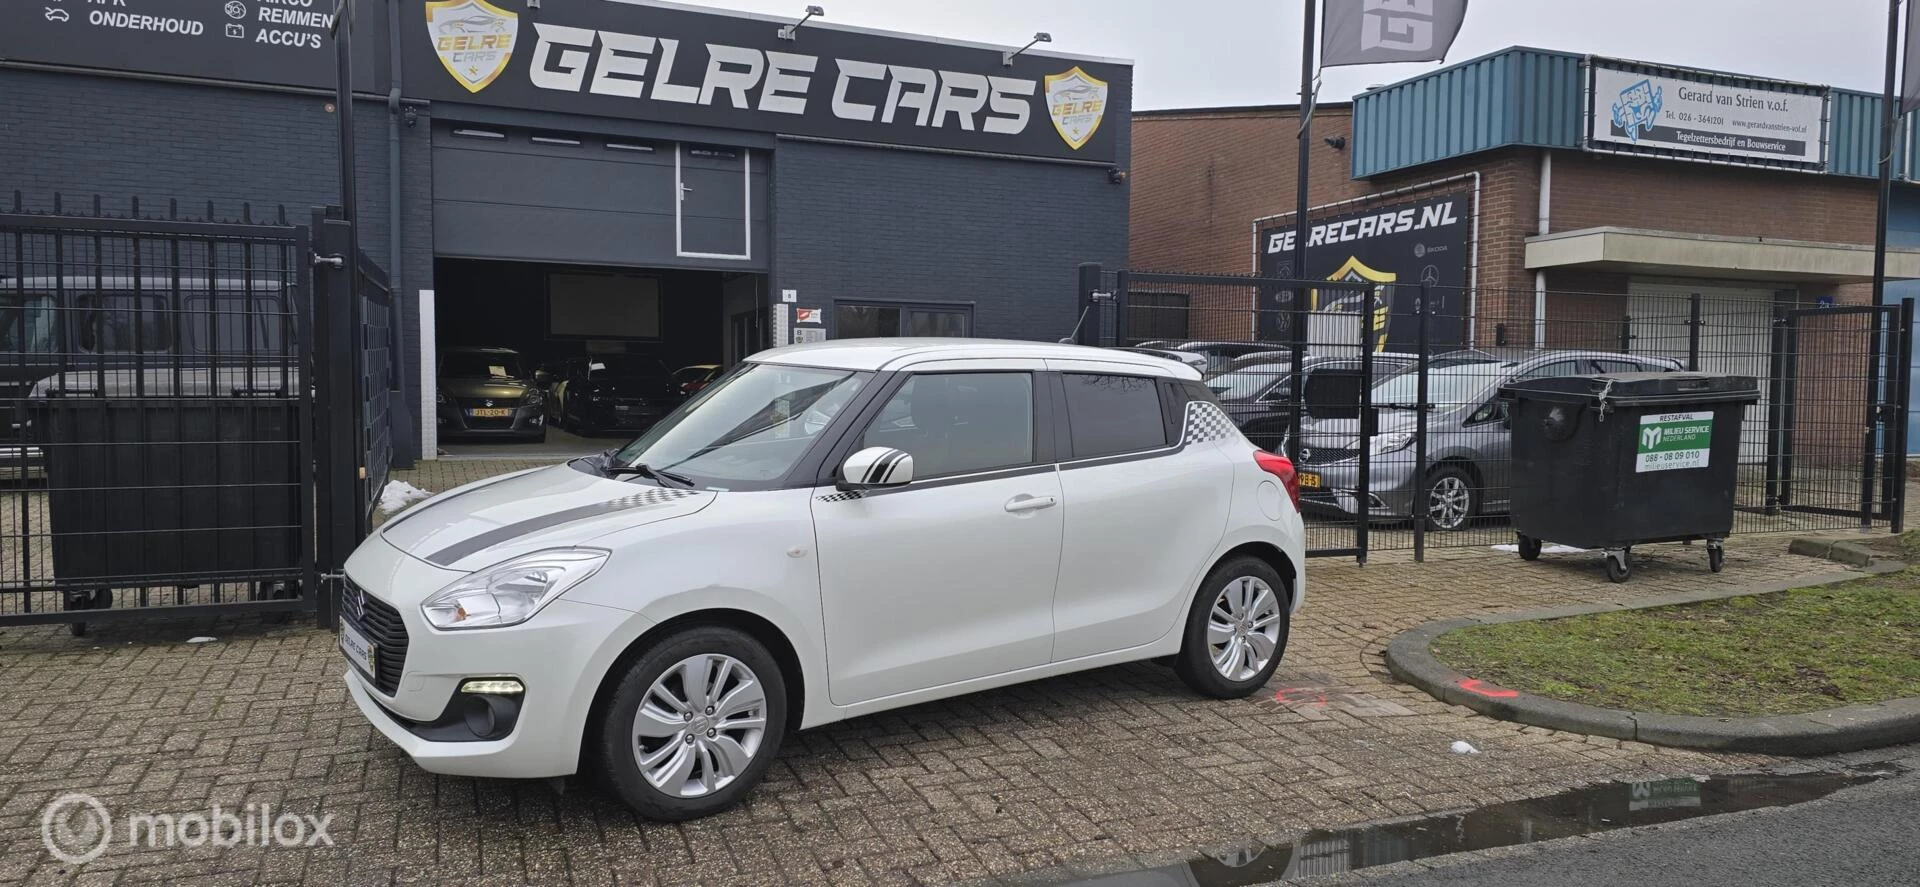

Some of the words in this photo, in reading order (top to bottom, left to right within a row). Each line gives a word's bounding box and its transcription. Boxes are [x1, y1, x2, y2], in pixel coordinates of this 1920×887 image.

[89, 10, 204, 36] ONDERHOUD
[258, 6, 334, 29] REMMEN
[255, 28, 322, 49] ACCU'S
[437, 33, 512, 51] GELRE
[453, 50, 498, 63] CARS
[530, 22, 819, 115] GELRE
[831, 58, 1037, 135] CARS
[1678, 86, 1713, 104] Gerard
[1716, 94, 1733, 106] van
[1736, 94, 1764, 109] Strien
[1767, 99, 1789, 112] v.o.f.
[1051, 100, 1103, 116] GELRE
[1665, 110, 1676, 120] Tel.
[1678, 112, 1692, 122] 026
[1698, 115, 1724, 126] 3641201
[1675, 130, 1737, 148] Tegelzettersbedrijf
[1737, 139, 1746, 148] en
[1747, 138, 1786, 152] Bouwservice
[1267, 201, 1458, 254] GERECARS.NL
[1659, 413, 1694, 422] RESTAFVAL
[1662, 433, 1697, 442] NEDERLAND
[1663, 427, 1684, 436] MILIEU
[1684, 425, 1710, 434] SERVICE
[1645, 453, 1659, 463] 088
[1663, 452, 1674, 461] 08
[1674, 451, 1684, 460] 09
[1685, 450, 1700, 459] 010
[1645, 459, 1701, 470] milieuservice.nl
